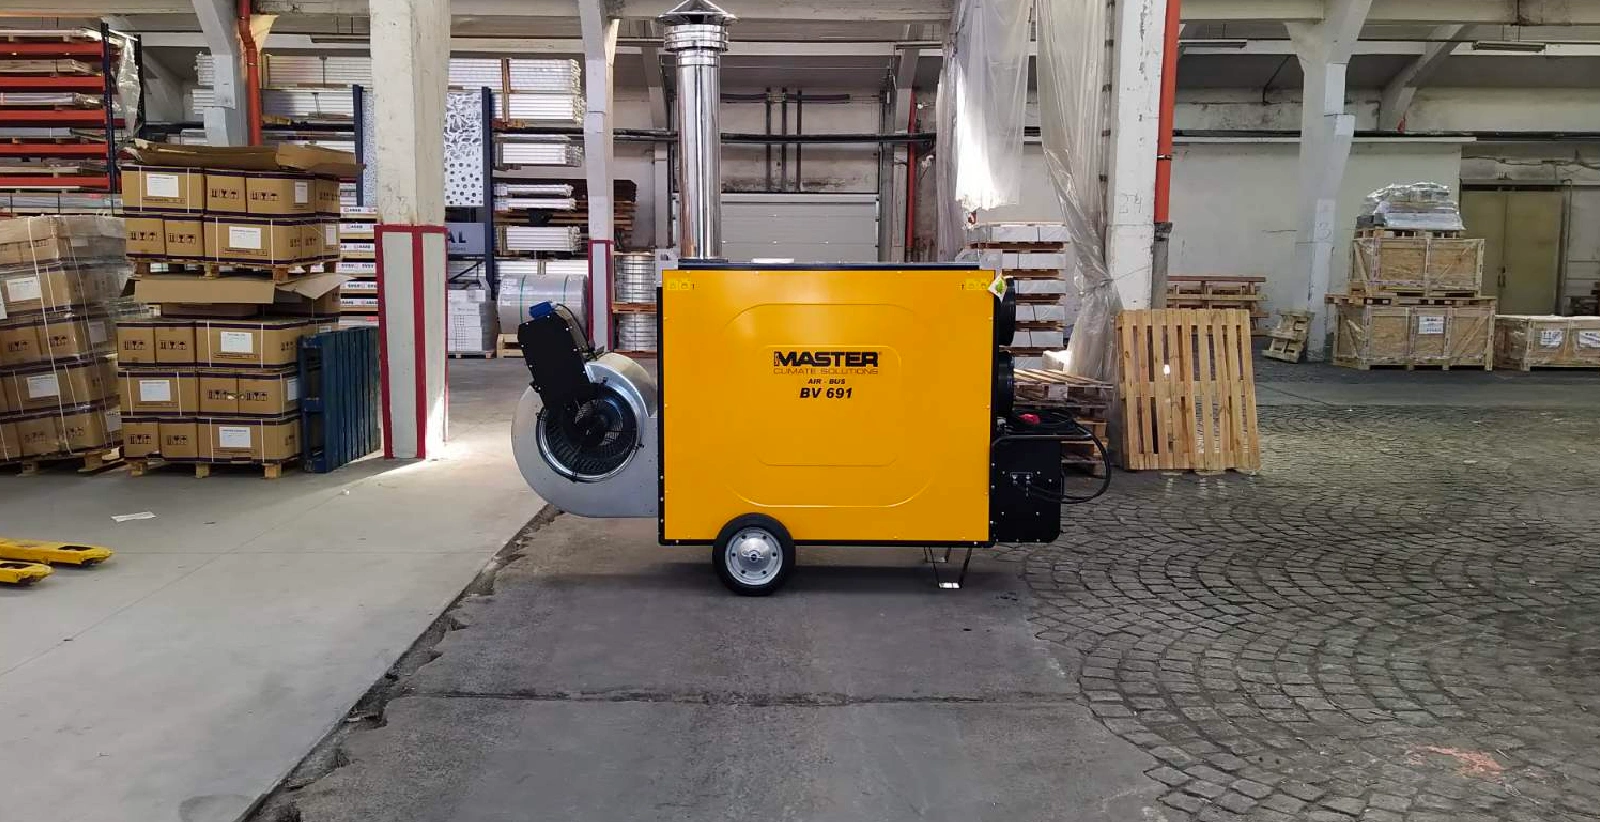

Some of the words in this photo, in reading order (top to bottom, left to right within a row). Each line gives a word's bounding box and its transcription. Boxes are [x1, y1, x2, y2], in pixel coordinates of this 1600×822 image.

[773, 351, 879, 367] MASTER
[800, 388, 821, 398] BV
[826, 387, 852, 398] 691
